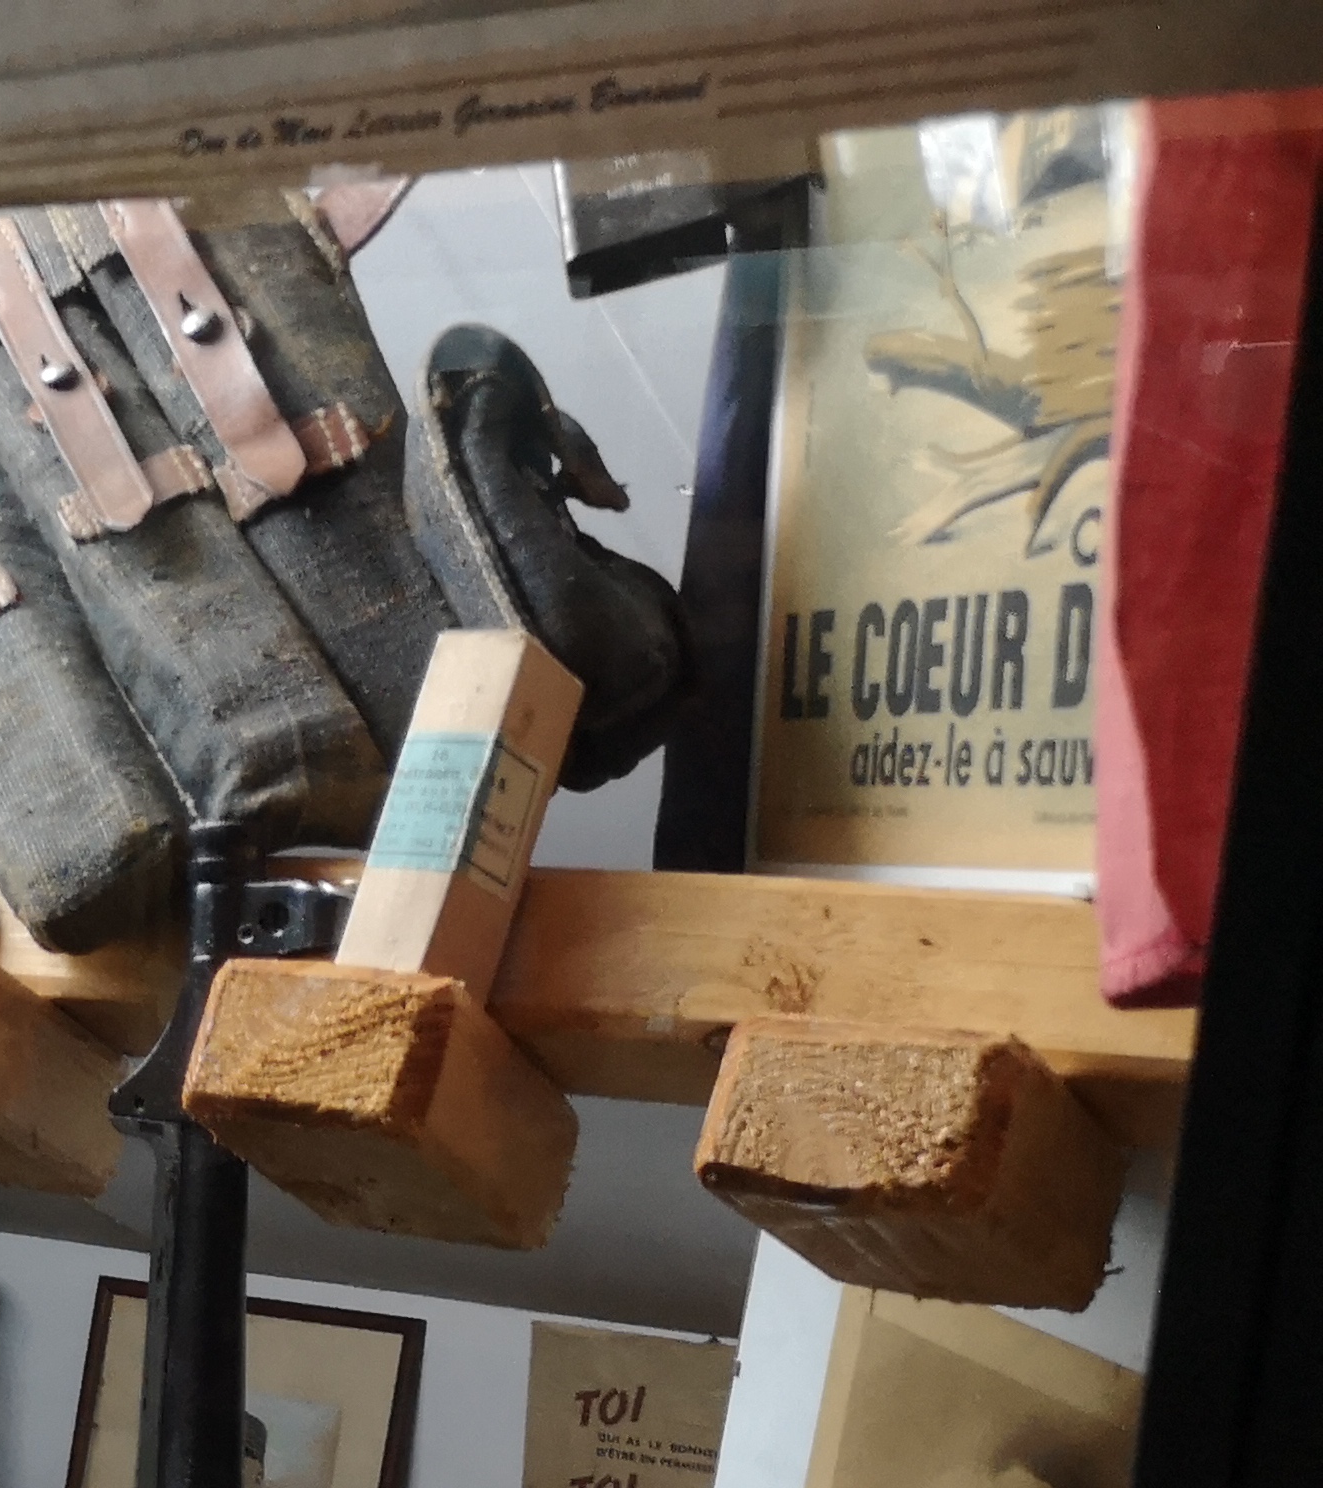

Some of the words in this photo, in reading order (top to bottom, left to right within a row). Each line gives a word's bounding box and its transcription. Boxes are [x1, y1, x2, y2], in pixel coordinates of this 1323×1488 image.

[780, 610, 835, 720] LE
[851, 722, 972, 787] aidez-le
[986, 727, 1006, 787] à
[575, 1386, 646, 1427] TOI
